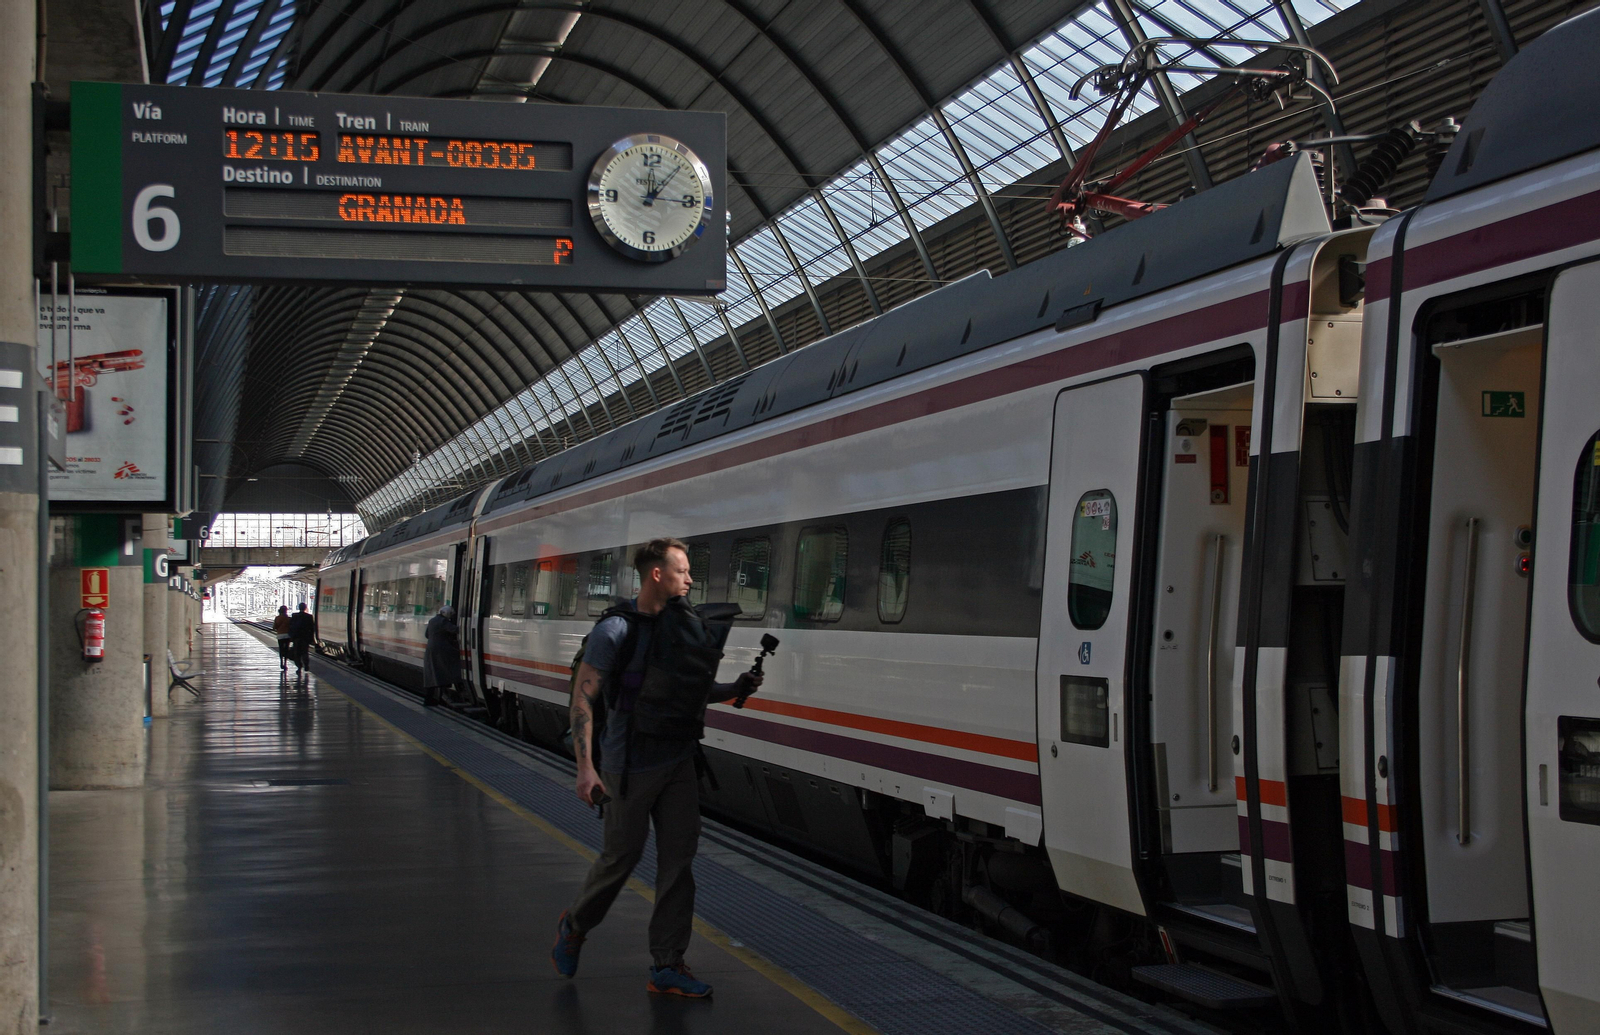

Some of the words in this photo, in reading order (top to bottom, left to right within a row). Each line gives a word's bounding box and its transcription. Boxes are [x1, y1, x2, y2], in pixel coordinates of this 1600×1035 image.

[132, 101, 162, 120] Vía
[222, 106, 266, 125] Hora
[288, 116, 315, 128] TIME
[336, 112, 376, 130] Tren
[399, 120, 430, 133] TRAIN
[132, 131, 188, 145] PLATFORM
[225, 130, 319, 162] 12:15
[641, 153, 662, 168] 12
[222, 164, 293, 184] Destino
[316, 174, 382, 188] DESTINATION
[339, 193, 465, 225] GRANADA
[604, 189, 619, 203] 9
[681, 194, 696, 209] 3
[131, 183, 181, 252] 6
[642, 230, 656, 245] 6
[553, 238, 573, 265] P
[199, 525, 209, 539] 6
[155, 553, 169, 578] G
[1268, 875, 1284, 883] EXTREMO
[1351, 901, 1366, 910] EXTREMO
